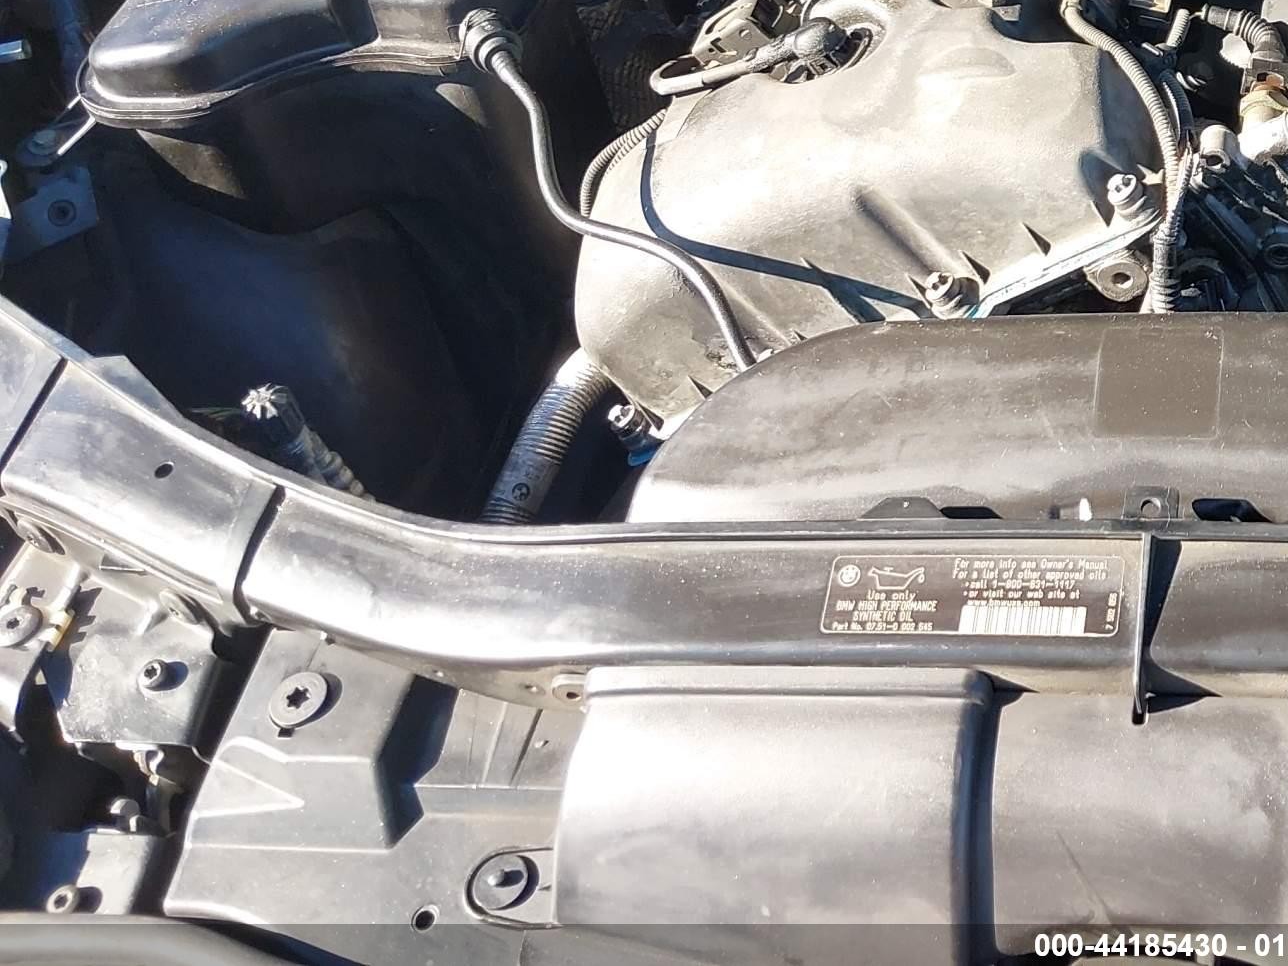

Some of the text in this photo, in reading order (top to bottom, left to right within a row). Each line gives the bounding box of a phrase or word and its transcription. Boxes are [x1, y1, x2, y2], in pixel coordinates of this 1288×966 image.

[953, 558, 969, 568] For
[974, 560, 995, 569] more
[999, 558, 1017, 569] info
[1021, 561, 1037, 569] see
[1041, 558, 1074, 569] Owner's
[952, 568, 969, 578] For
[983, 568, 999, 579] list
[1002, 569, 1014, 579] of
[1017, 569, 1041, 579] other
[1045, 569, 1085, 581] approved
[866, 589, 916, 602] Use only
[983, 589, 1004, 598] visit
[1008, 591, 1023, 599] our
[1027, 589, 1044, 599] web
[1047, 590, 1066, 599] site
[1069, 589, 1080, 599] at
[835, 600, 938, 611] BMW HIGH PERFORMANCE
[852, 611, 914, 621] SYNTHETIC OIL
[832, 622, 849, 631] Part
